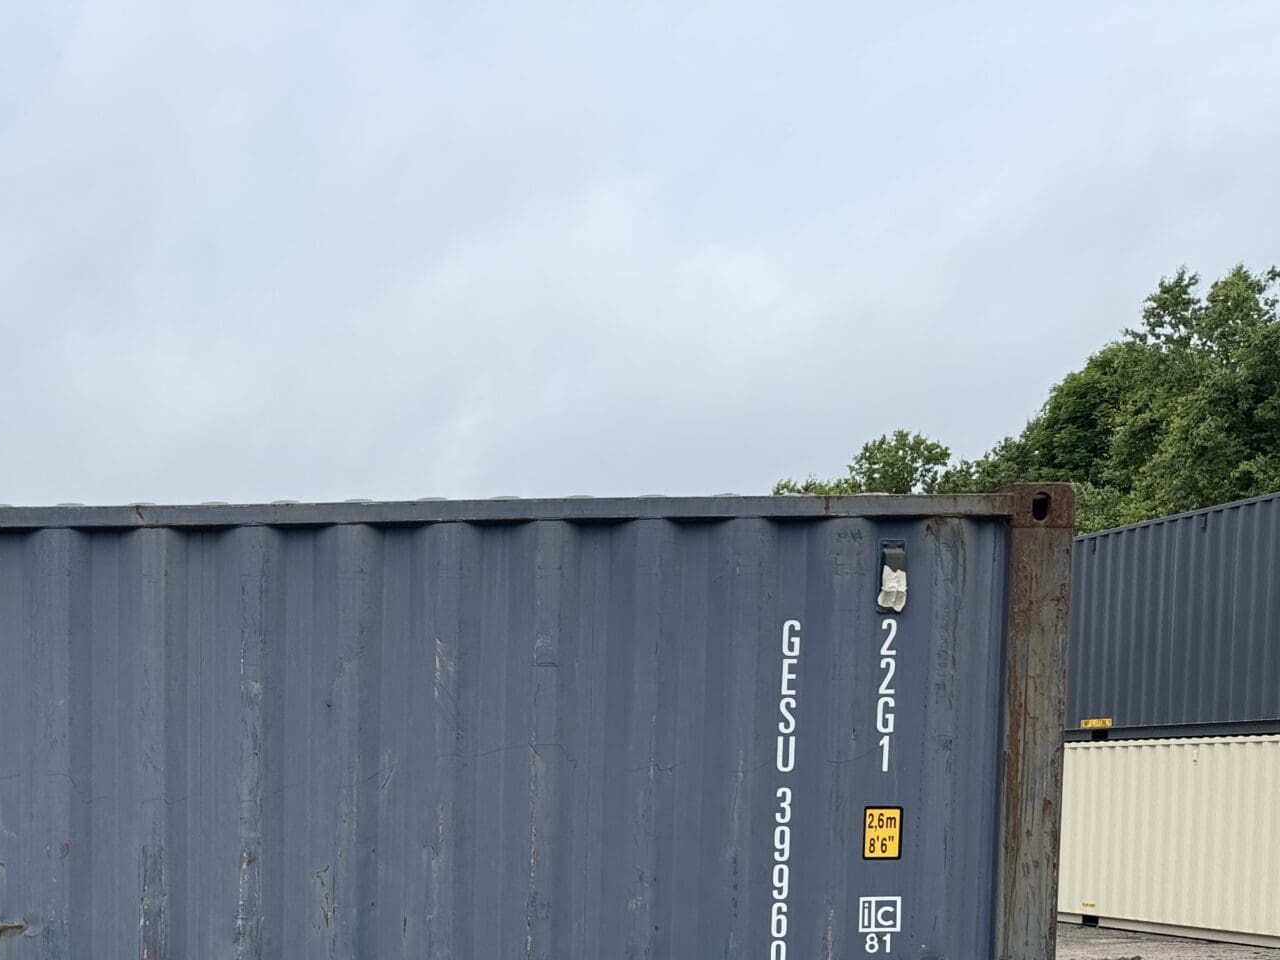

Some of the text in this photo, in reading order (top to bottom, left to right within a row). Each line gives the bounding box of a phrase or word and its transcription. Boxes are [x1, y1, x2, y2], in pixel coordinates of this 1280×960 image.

[776, 619, 801, 772] GESU
[876, 618, 897, 772] 22G1
[867, 813, 897, 831] 2,6m
[864, 933, 891, 953] 81
